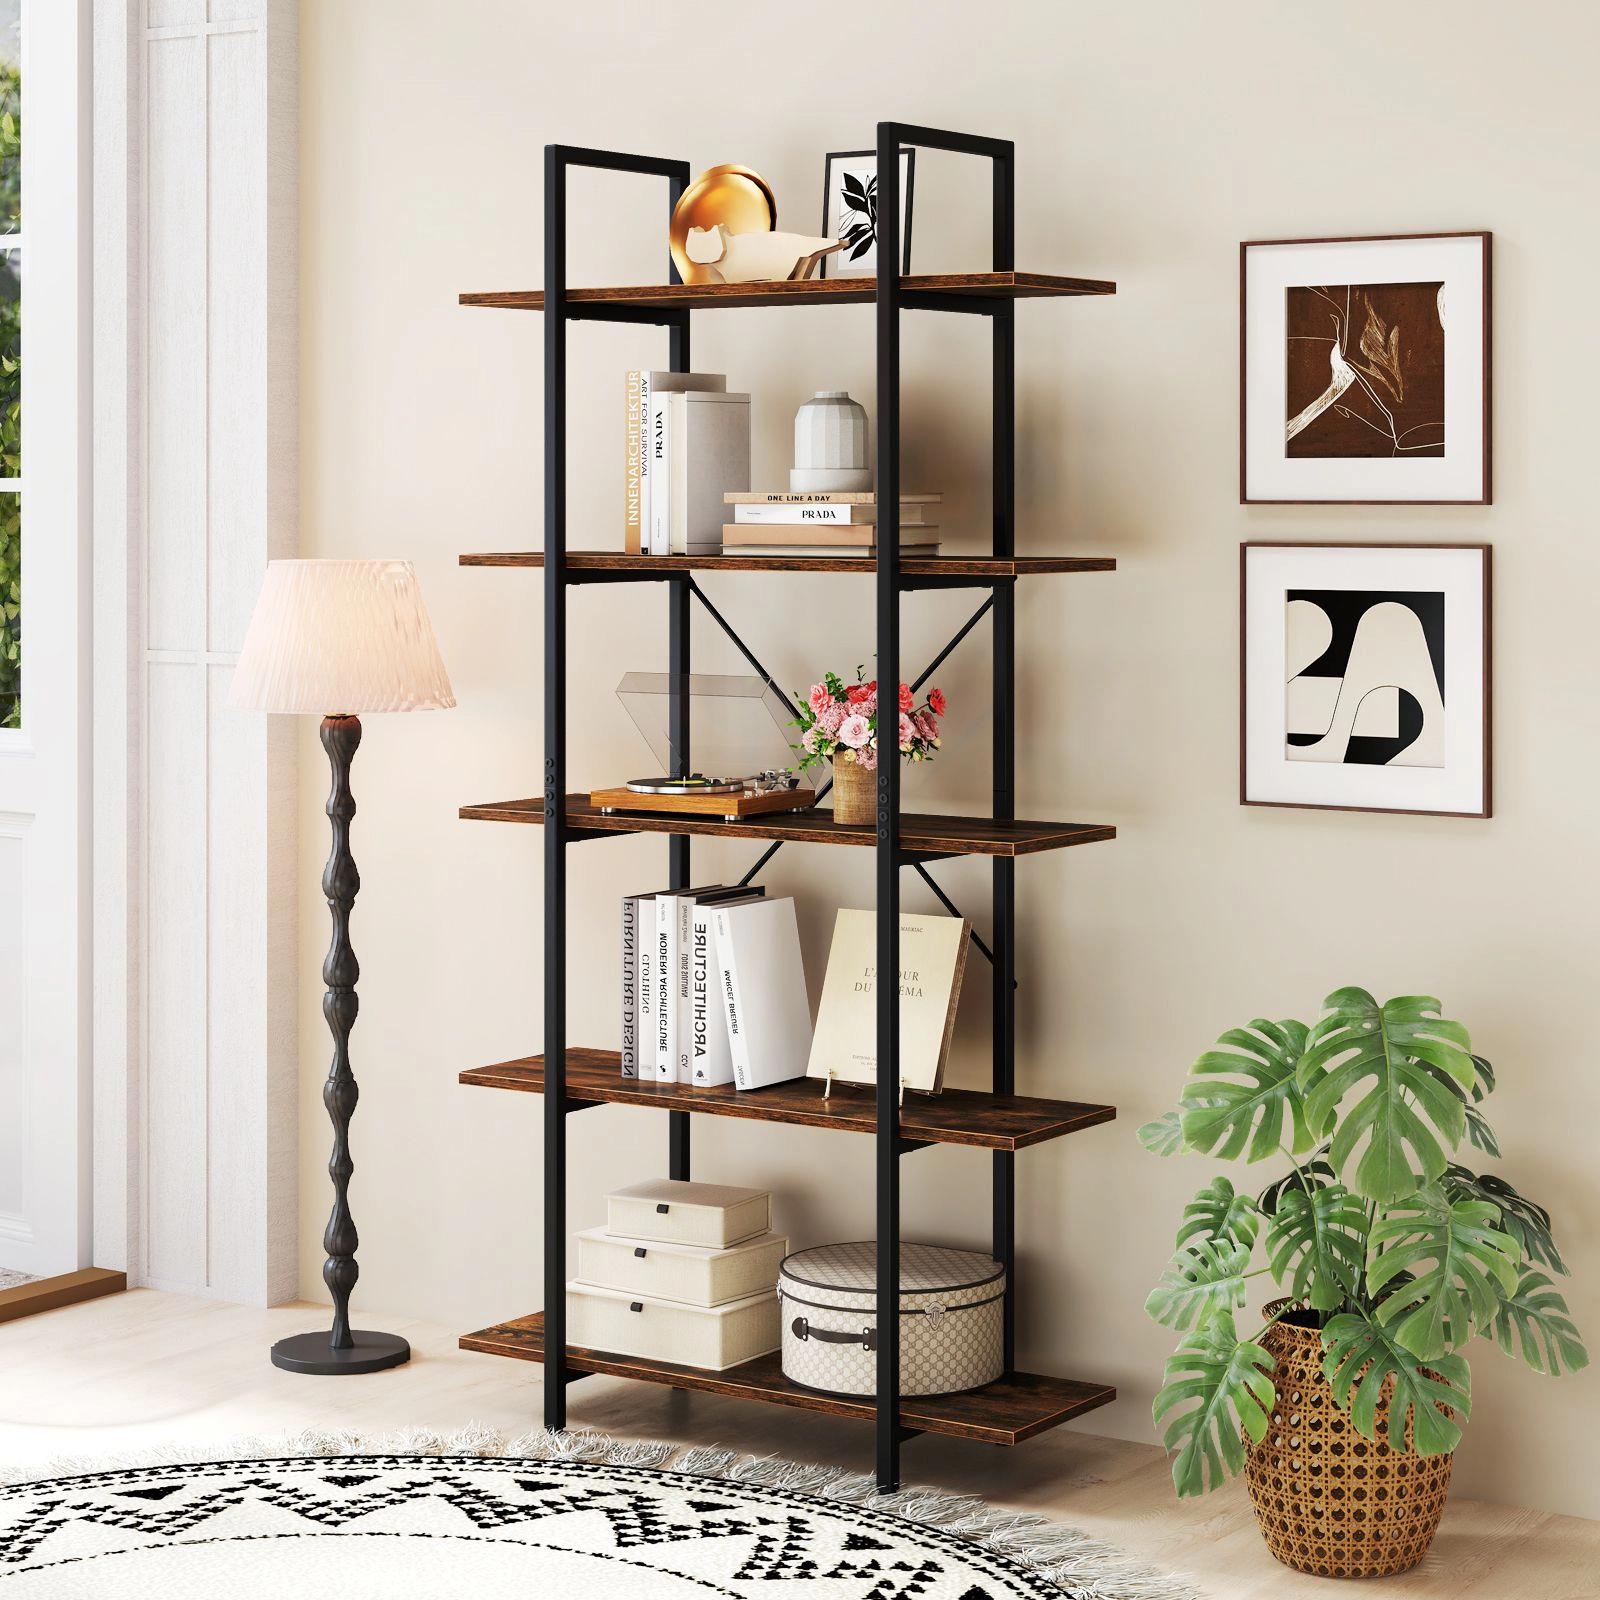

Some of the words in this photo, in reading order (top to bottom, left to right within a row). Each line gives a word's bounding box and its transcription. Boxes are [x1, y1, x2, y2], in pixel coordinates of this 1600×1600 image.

[628, 371, 639, 526] INNENARCHITEKTUR
[655, 411, 663, 459] PRADA
[802, 510, 836, 519] PRADA
[854, 982, 872, 993] DU
